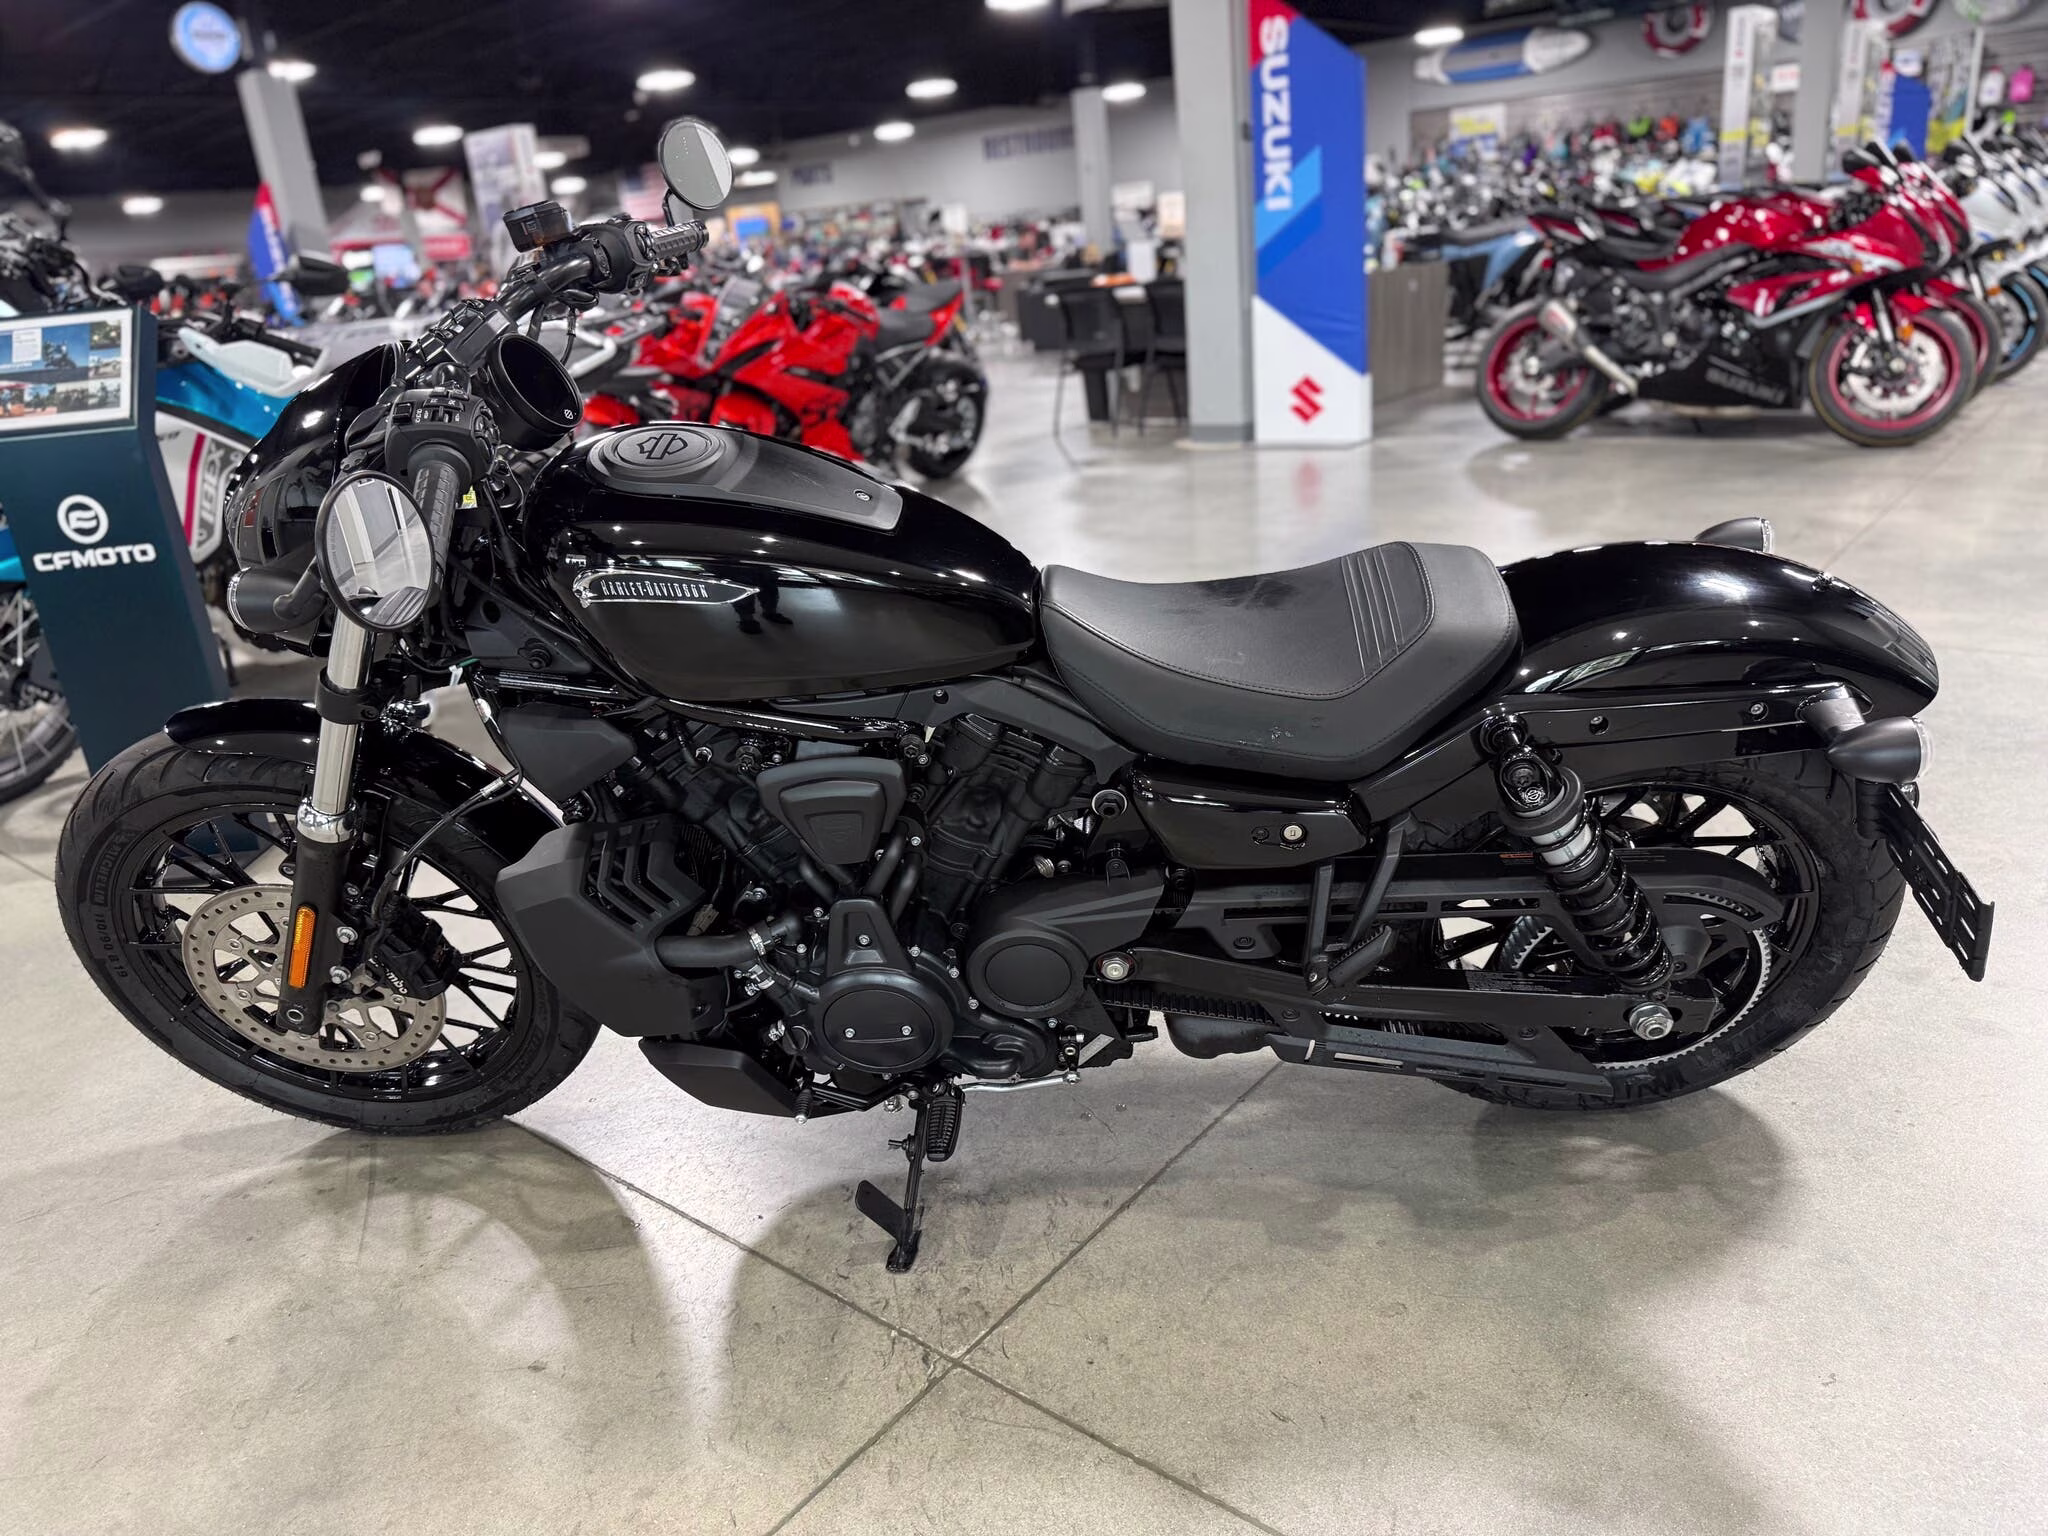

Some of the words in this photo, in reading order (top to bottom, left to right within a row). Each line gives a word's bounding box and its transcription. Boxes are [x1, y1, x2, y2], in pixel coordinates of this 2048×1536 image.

[1259, 15, 1293, 211] SUZUKI
[33, 543, 157, 572] CFMOTO
[601, 579, 708, 599] HARLEY-DAVIDSON
